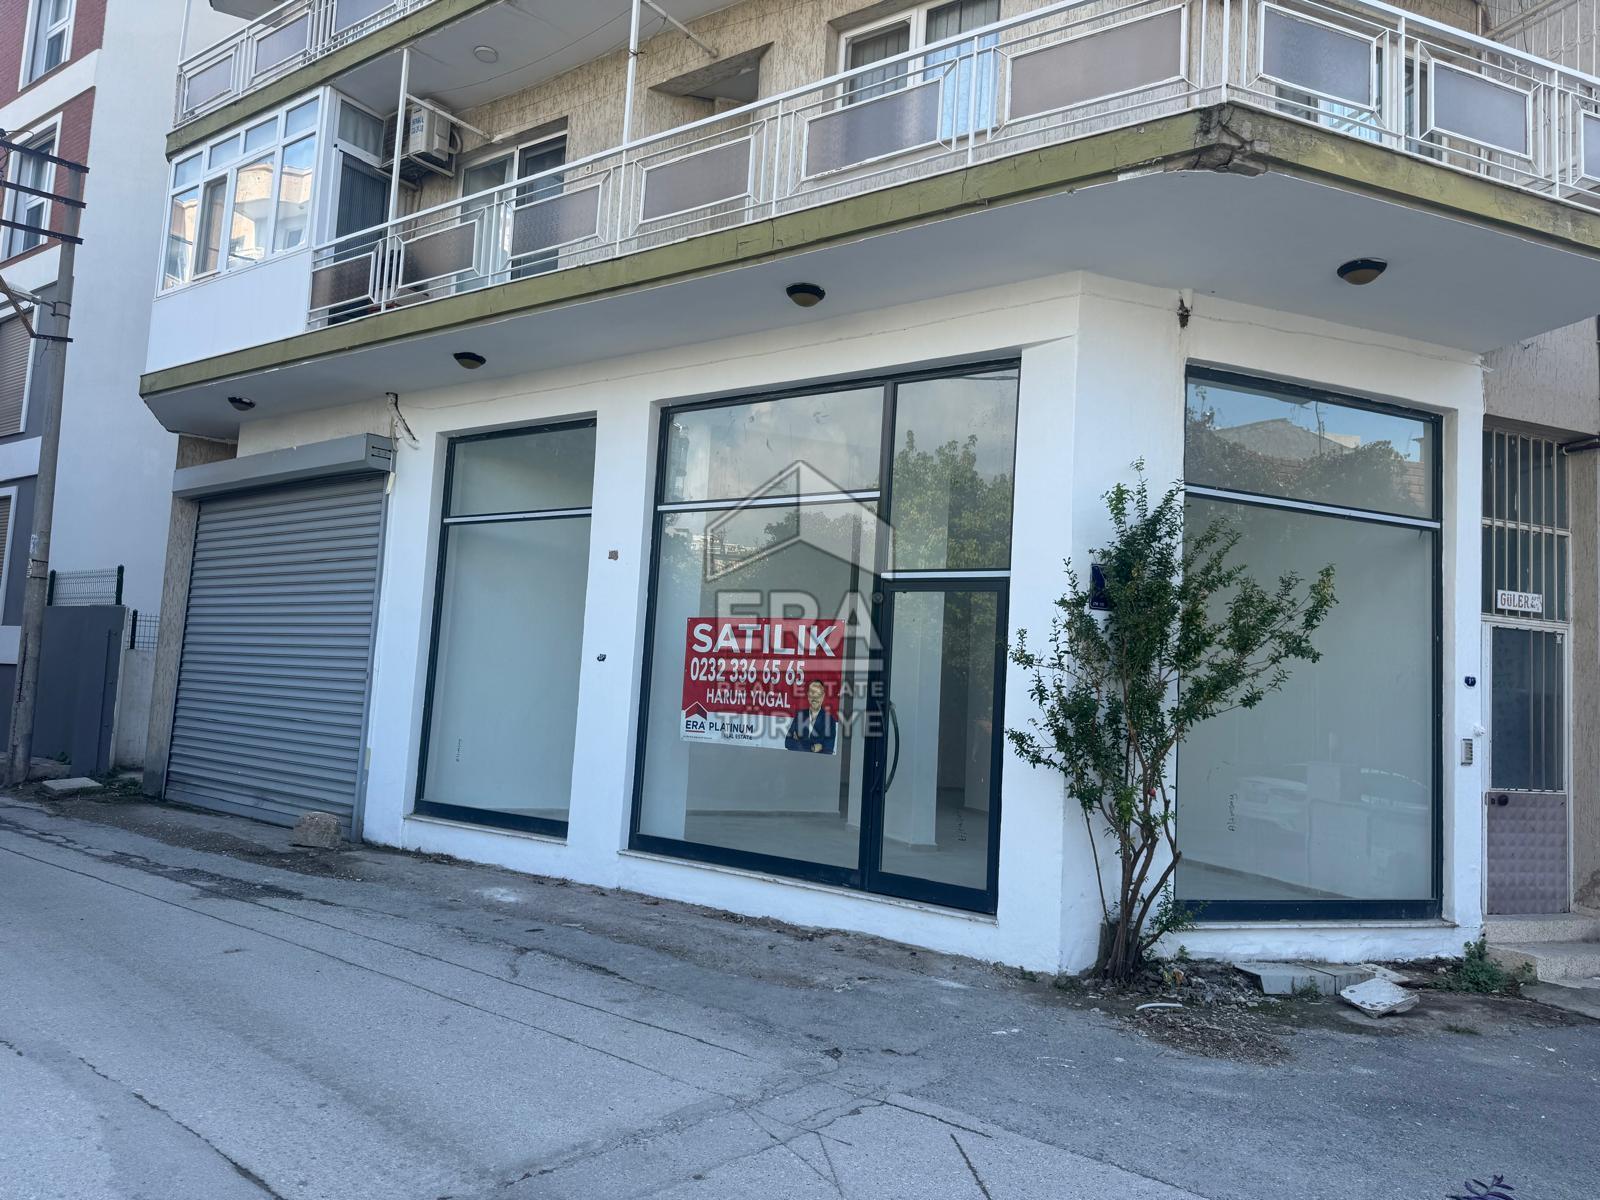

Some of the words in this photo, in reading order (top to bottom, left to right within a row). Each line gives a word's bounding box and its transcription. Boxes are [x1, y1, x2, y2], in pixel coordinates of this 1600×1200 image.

[1500, 592, 1530, 609] GÜLER
[691, 622, 838, 658] SATILIK
[690, 657, 726, 682] 0232
[729, 659, 757, 684] 336
[762, 659, 781, 685] 65
[785, 660, 805, 686] 65
[706, 688, 747, 706] HARUN
[685, 720, 705, 731] ERA
[708, 721, 754, 734] PLATINUM
